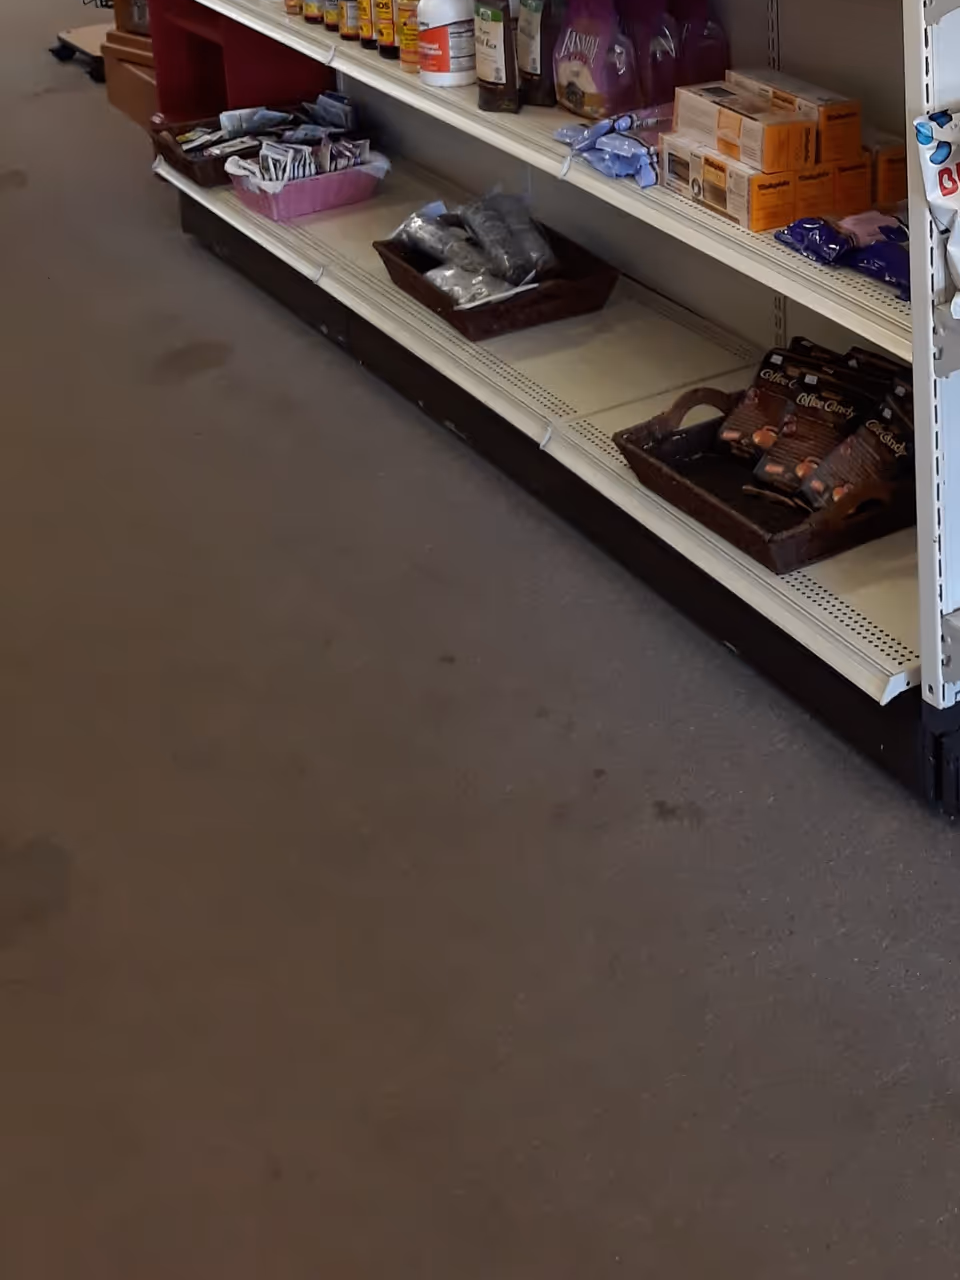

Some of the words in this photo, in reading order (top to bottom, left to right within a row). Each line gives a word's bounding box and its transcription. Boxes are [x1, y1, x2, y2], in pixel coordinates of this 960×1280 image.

[760, 369, 789, 387] Coffee
[796, 392, 824, 410] Coffee
[825, 400, 856, 419] Candy
